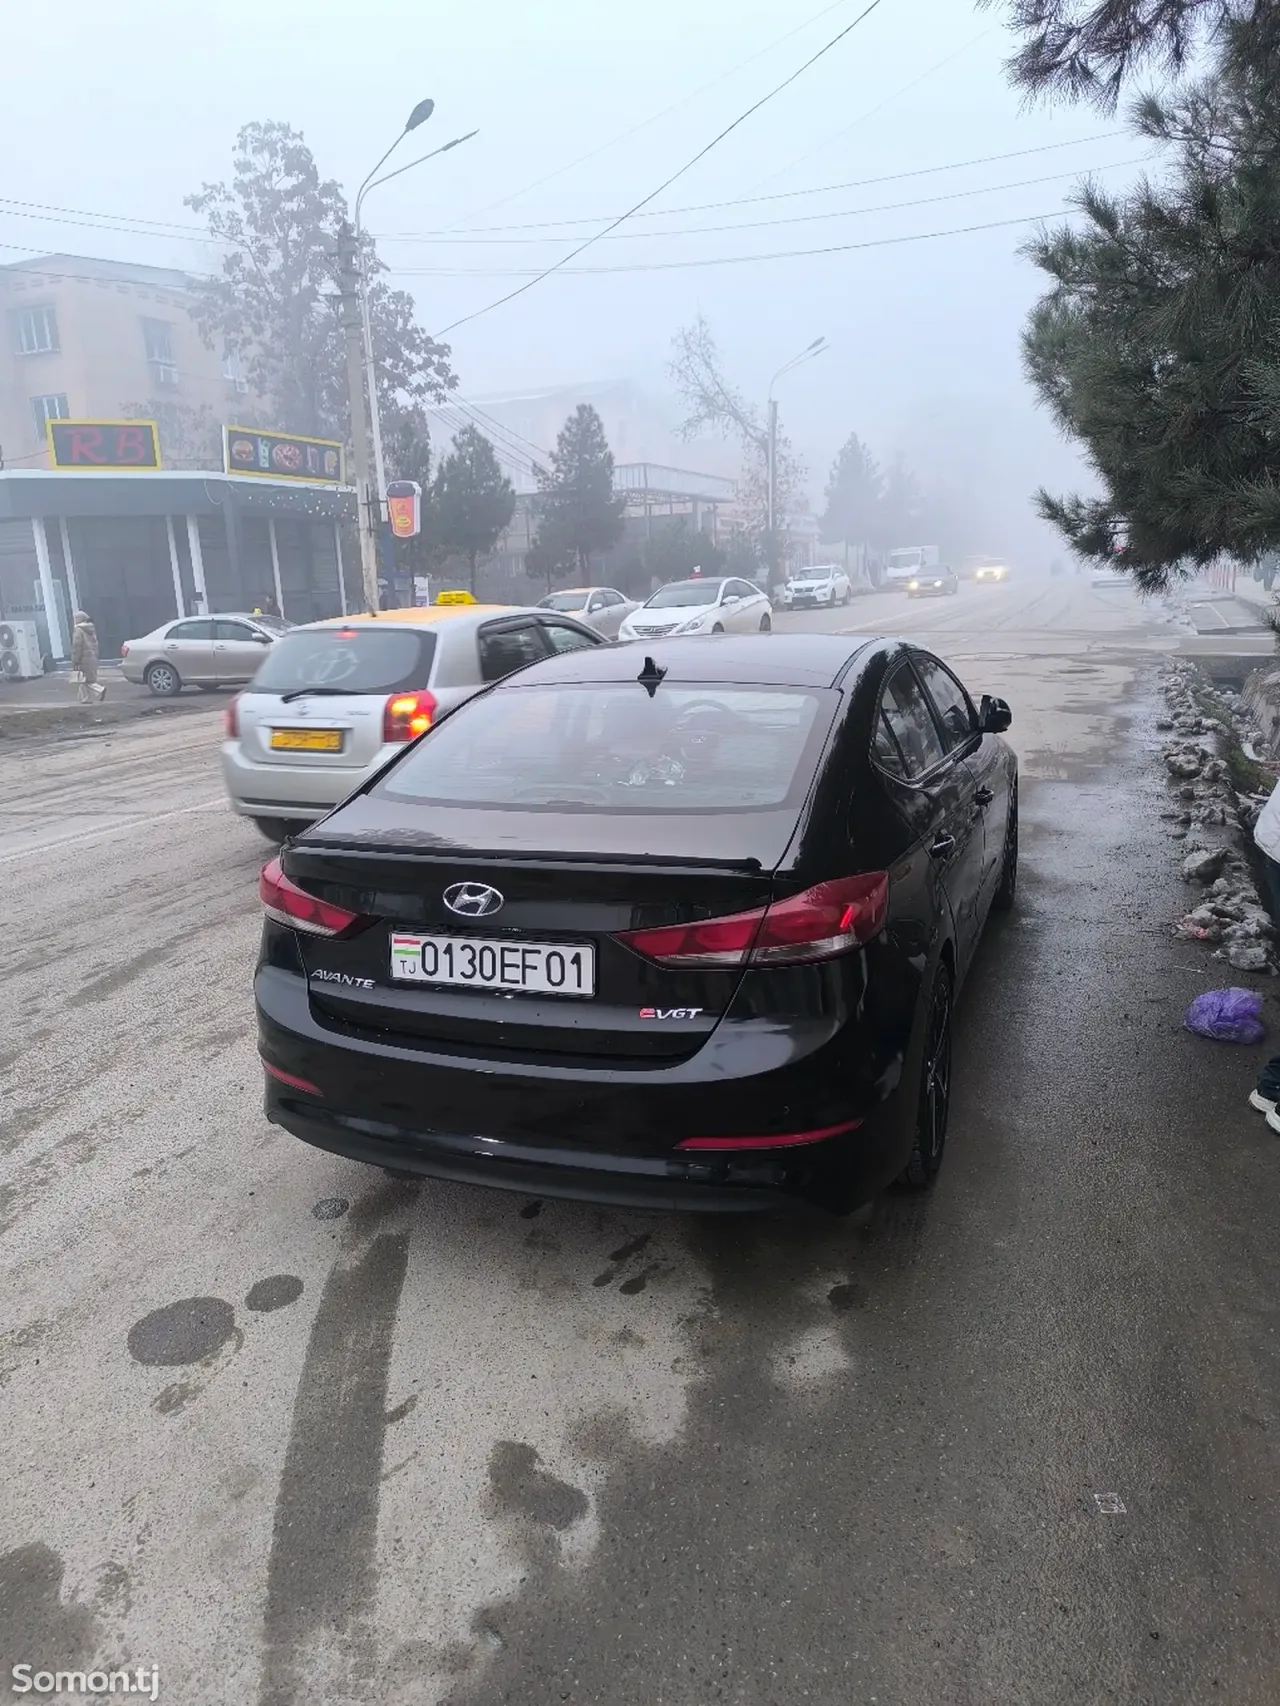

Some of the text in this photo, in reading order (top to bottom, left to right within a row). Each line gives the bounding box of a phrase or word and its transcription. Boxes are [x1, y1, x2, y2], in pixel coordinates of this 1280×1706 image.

[400, 960, 416, 974] TJ
[421, 941, 582, 988] 0130EF01
[311, 969, 376, 989] AVANTE
